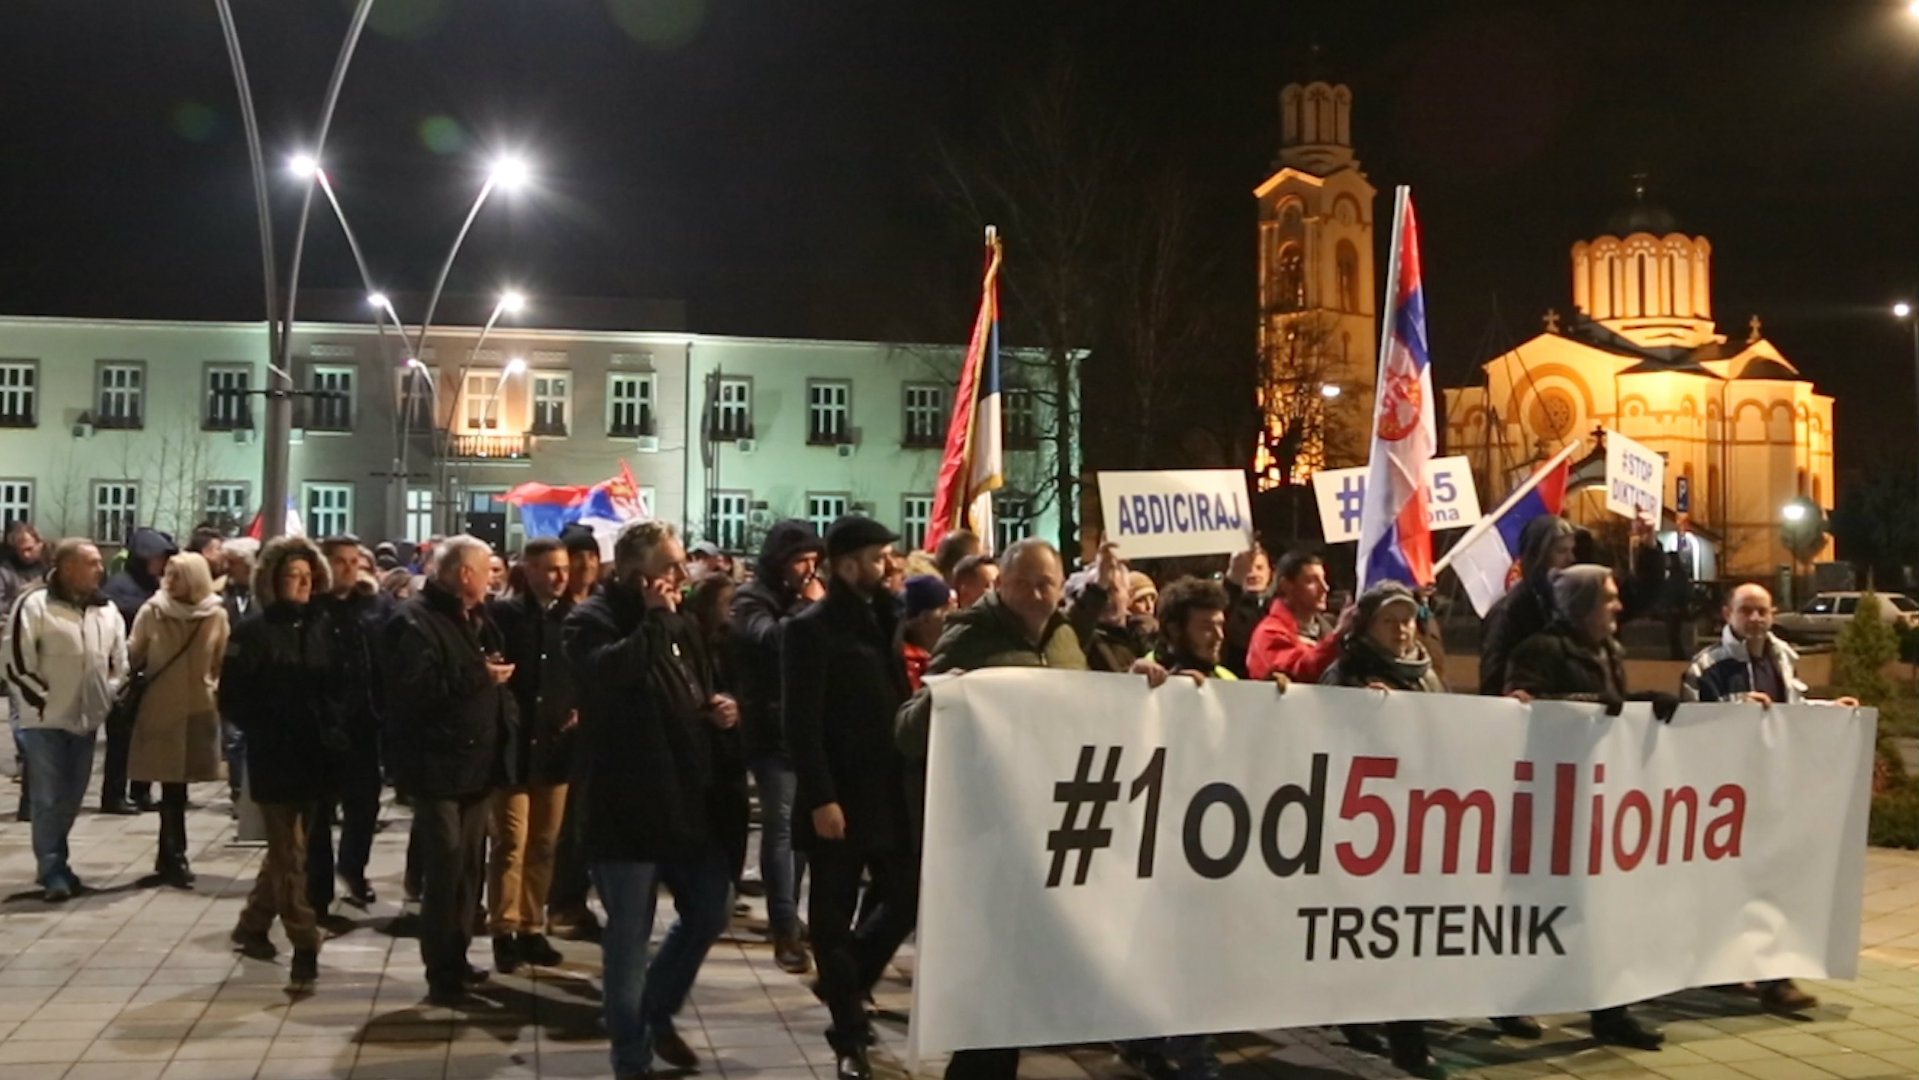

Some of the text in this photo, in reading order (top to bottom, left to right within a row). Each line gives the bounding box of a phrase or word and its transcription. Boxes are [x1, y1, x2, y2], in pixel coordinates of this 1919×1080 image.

[1118, 491, 1242, 536] ABDICIRAJ
[1045, 744, 1746, 888] #1od5miliona
[1297, 904, 1567, 960] TRSTENIK
